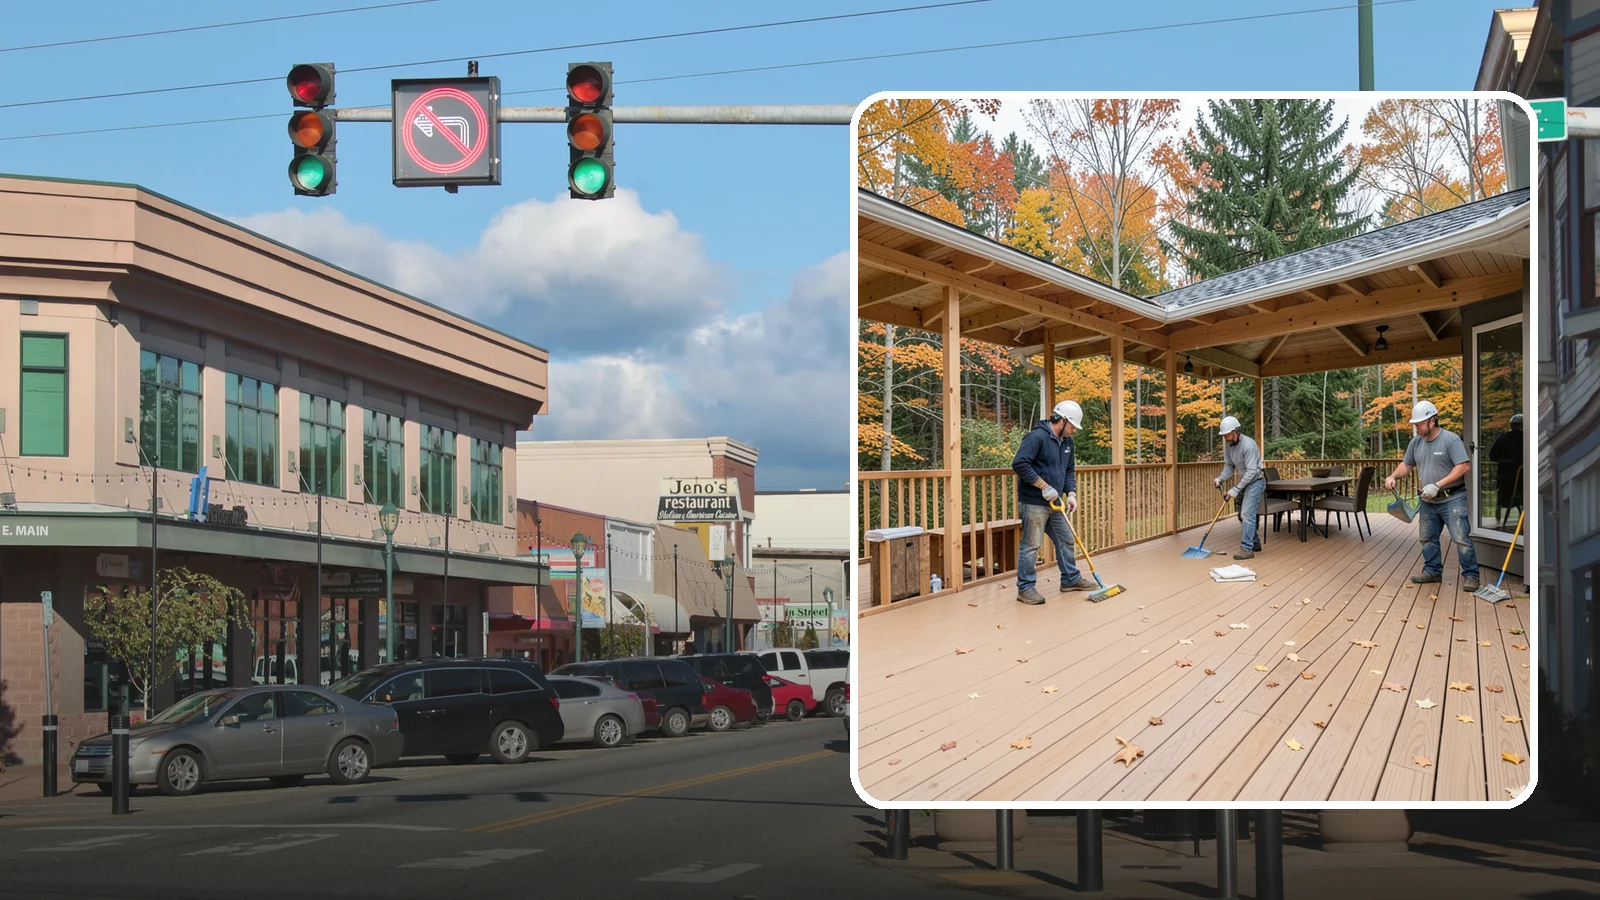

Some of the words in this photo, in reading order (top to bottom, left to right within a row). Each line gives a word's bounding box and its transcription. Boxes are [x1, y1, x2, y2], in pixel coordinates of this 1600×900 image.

[669, 480, 727, 494] Jeno's
[665, 496, 731, 508] restaurant
[658, 510, 681, 519] Italian
[686, 510, 714, 519] American
[715, 510, 737, 519] Cuisine
[2, 525, 13, 536] E.
[15, 525, 49, 536] MAIN
[785, 608, 794, 616] in
[797, 608, 828, 616] Street
[791, 619, 823, 627] lass
